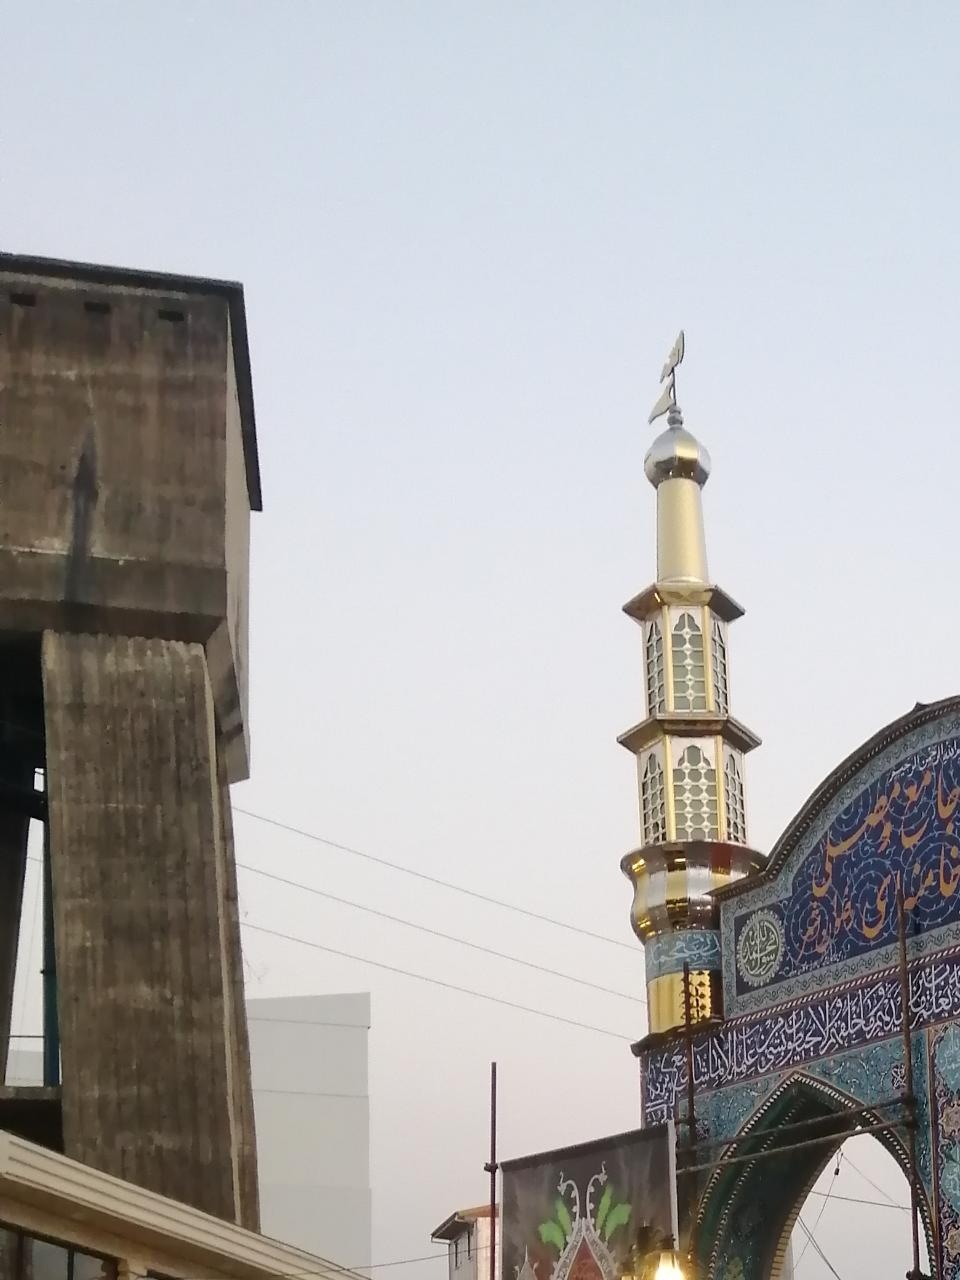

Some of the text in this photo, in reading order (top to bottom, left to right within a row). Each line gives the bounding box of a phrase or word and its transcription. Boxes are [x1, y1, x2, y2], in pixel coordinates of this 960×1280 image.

[888, 754, 919, 783] الرحیم
[901, 767, 960, 850] جامع
[812, 782, 901, 898] مصلی
